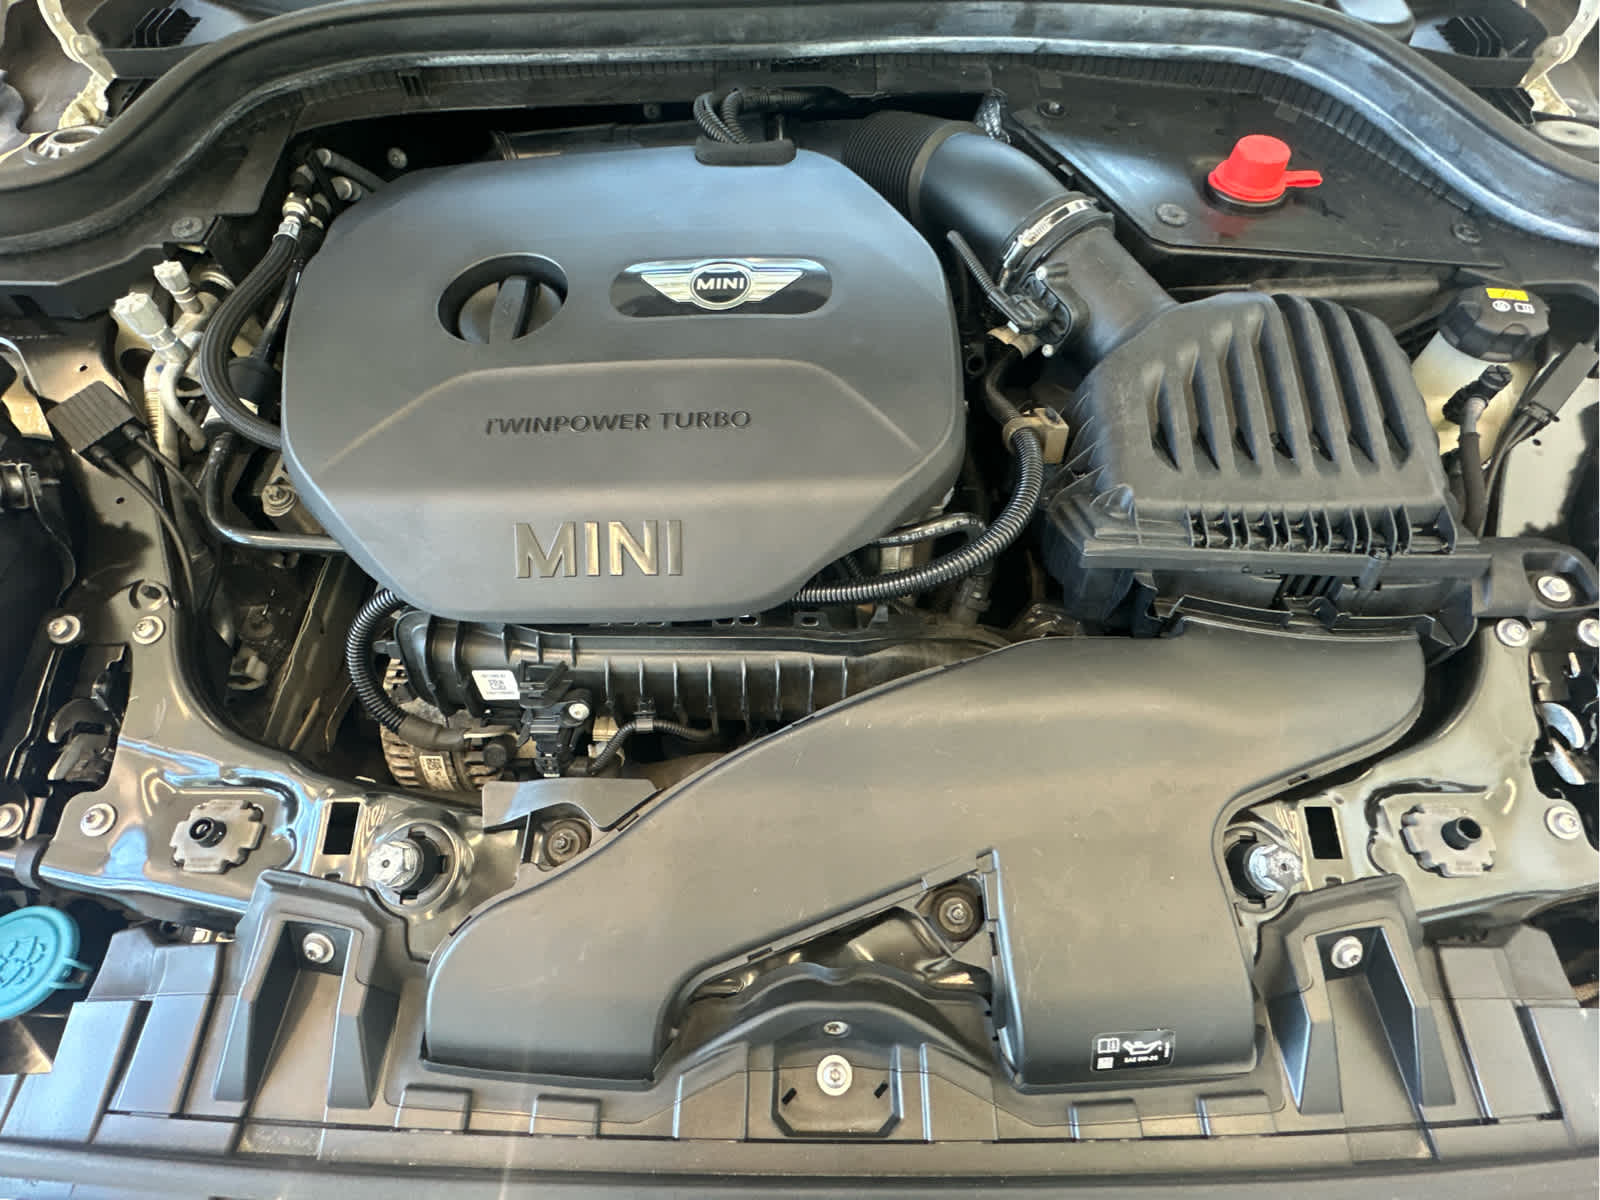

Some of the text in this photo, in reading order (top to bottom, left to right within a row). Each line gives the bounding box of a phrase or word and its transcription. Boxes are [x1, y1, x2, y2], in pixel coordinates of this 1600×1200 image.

[696, 277, 746, 291] MINI
[485, 410, 752, 435] TWINPOWER TURBO
[513, 519, 683, 578] MINI
